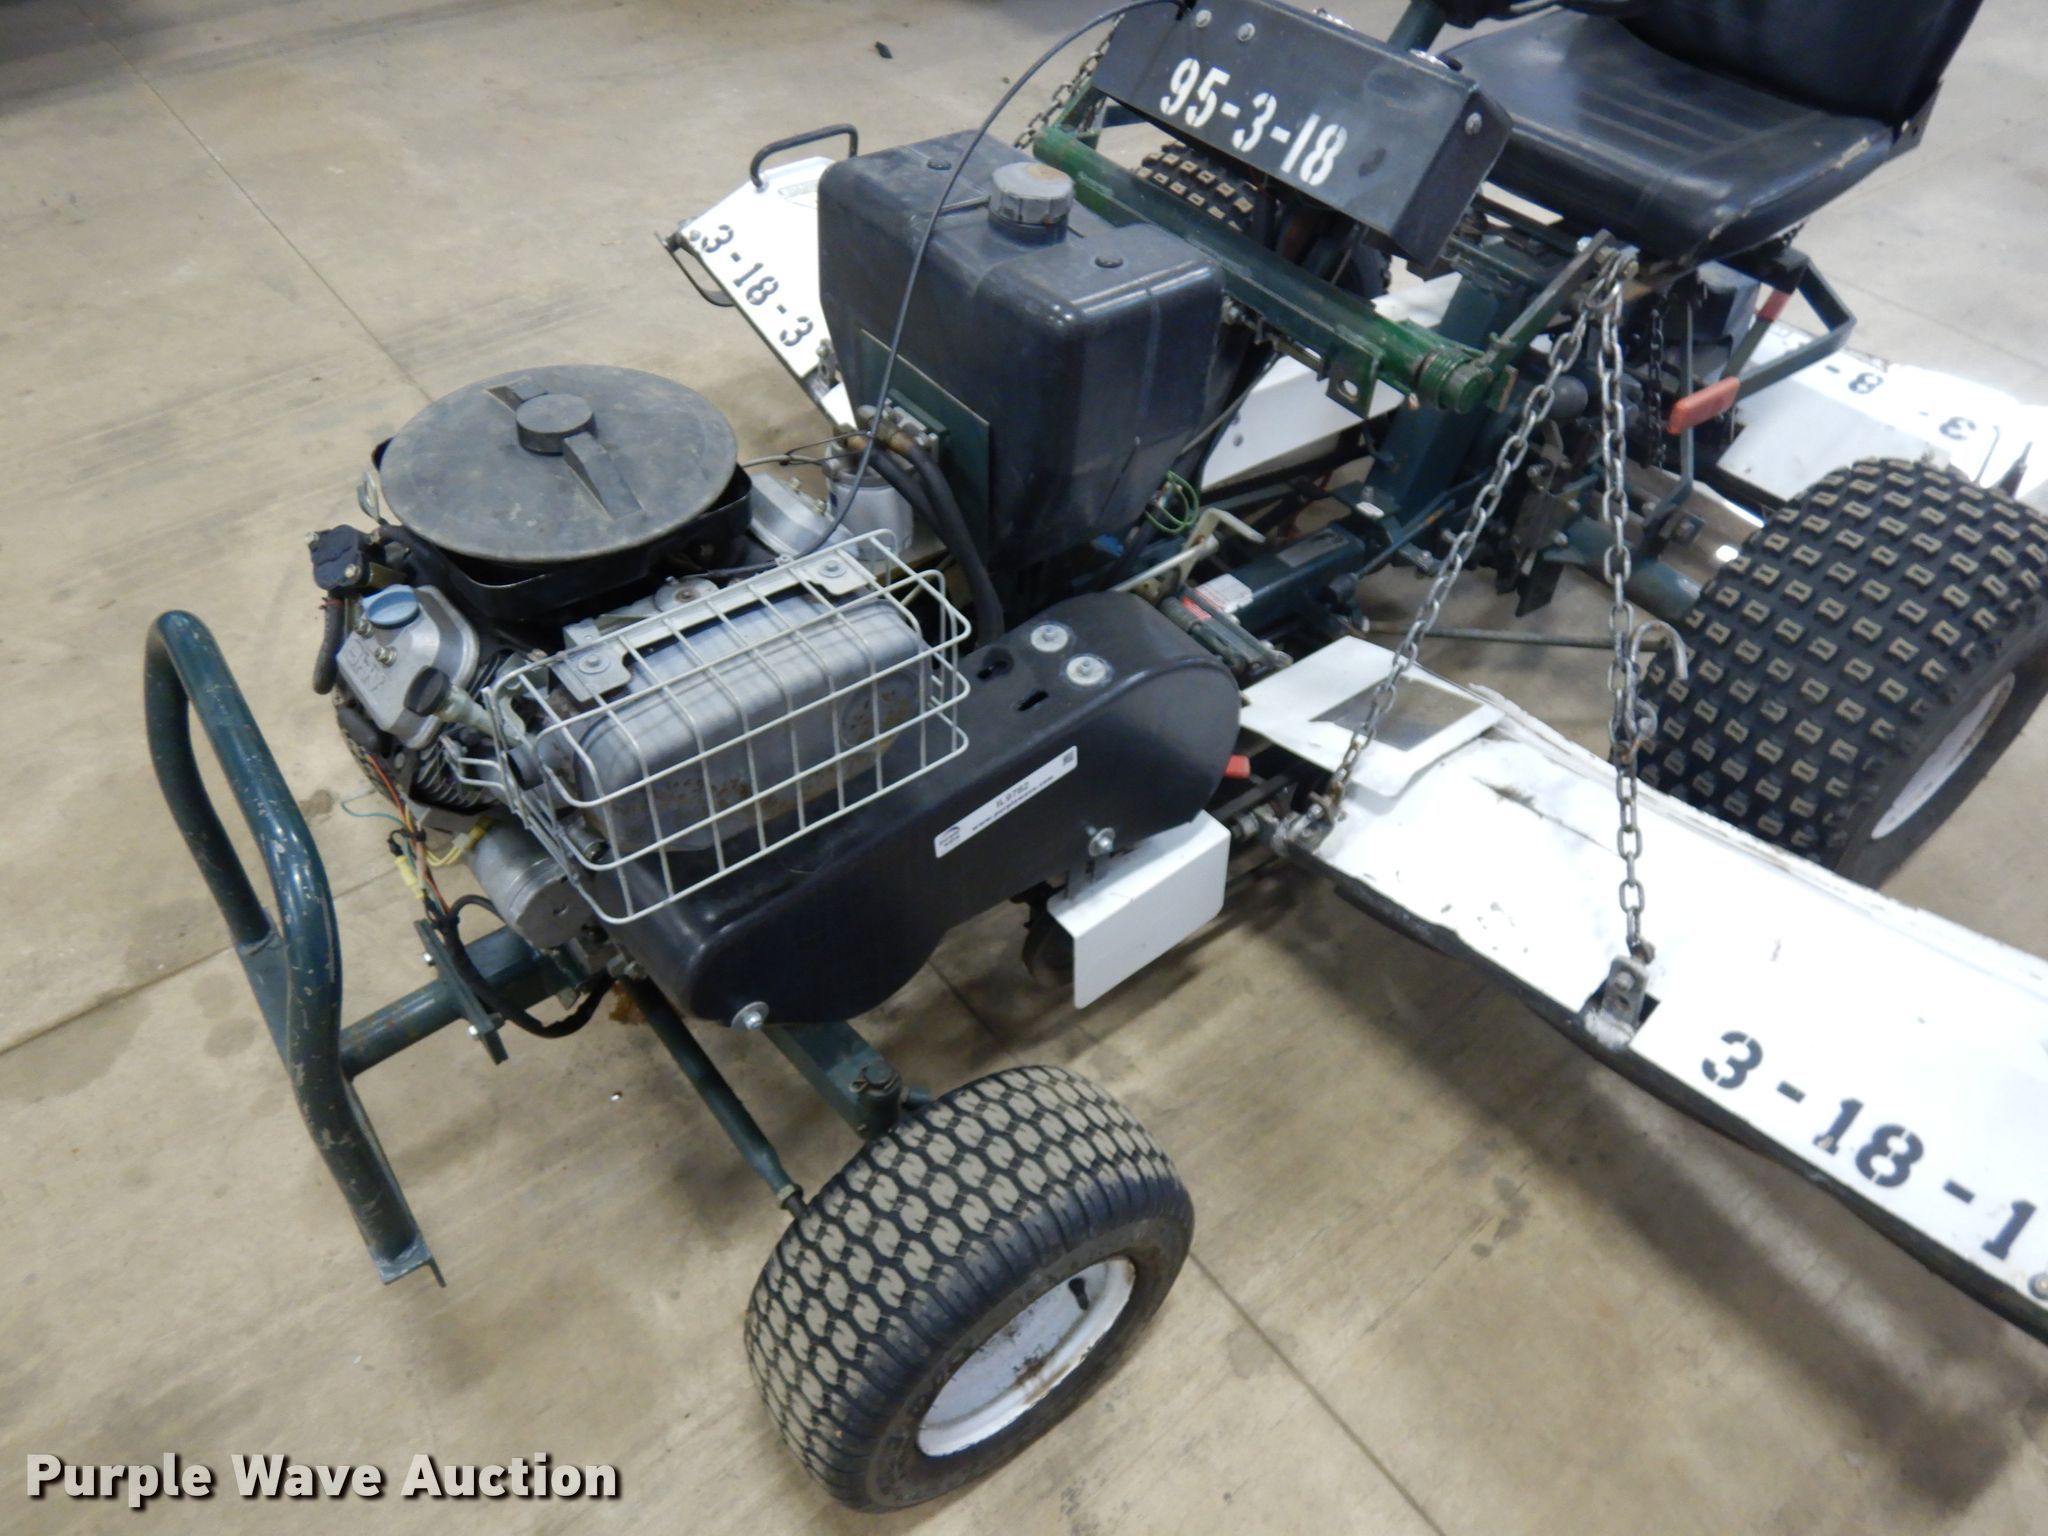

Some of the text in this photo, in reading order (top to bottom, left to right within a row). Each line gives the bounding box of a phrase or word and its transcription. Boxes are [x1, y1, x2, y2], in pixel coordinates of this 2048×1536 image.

[1160, 57, 1348, 186] 95-3-18
[701, 224, 814, 347] 3-18-3
[1701, 1030, 2037, 1261] 3-18-1
